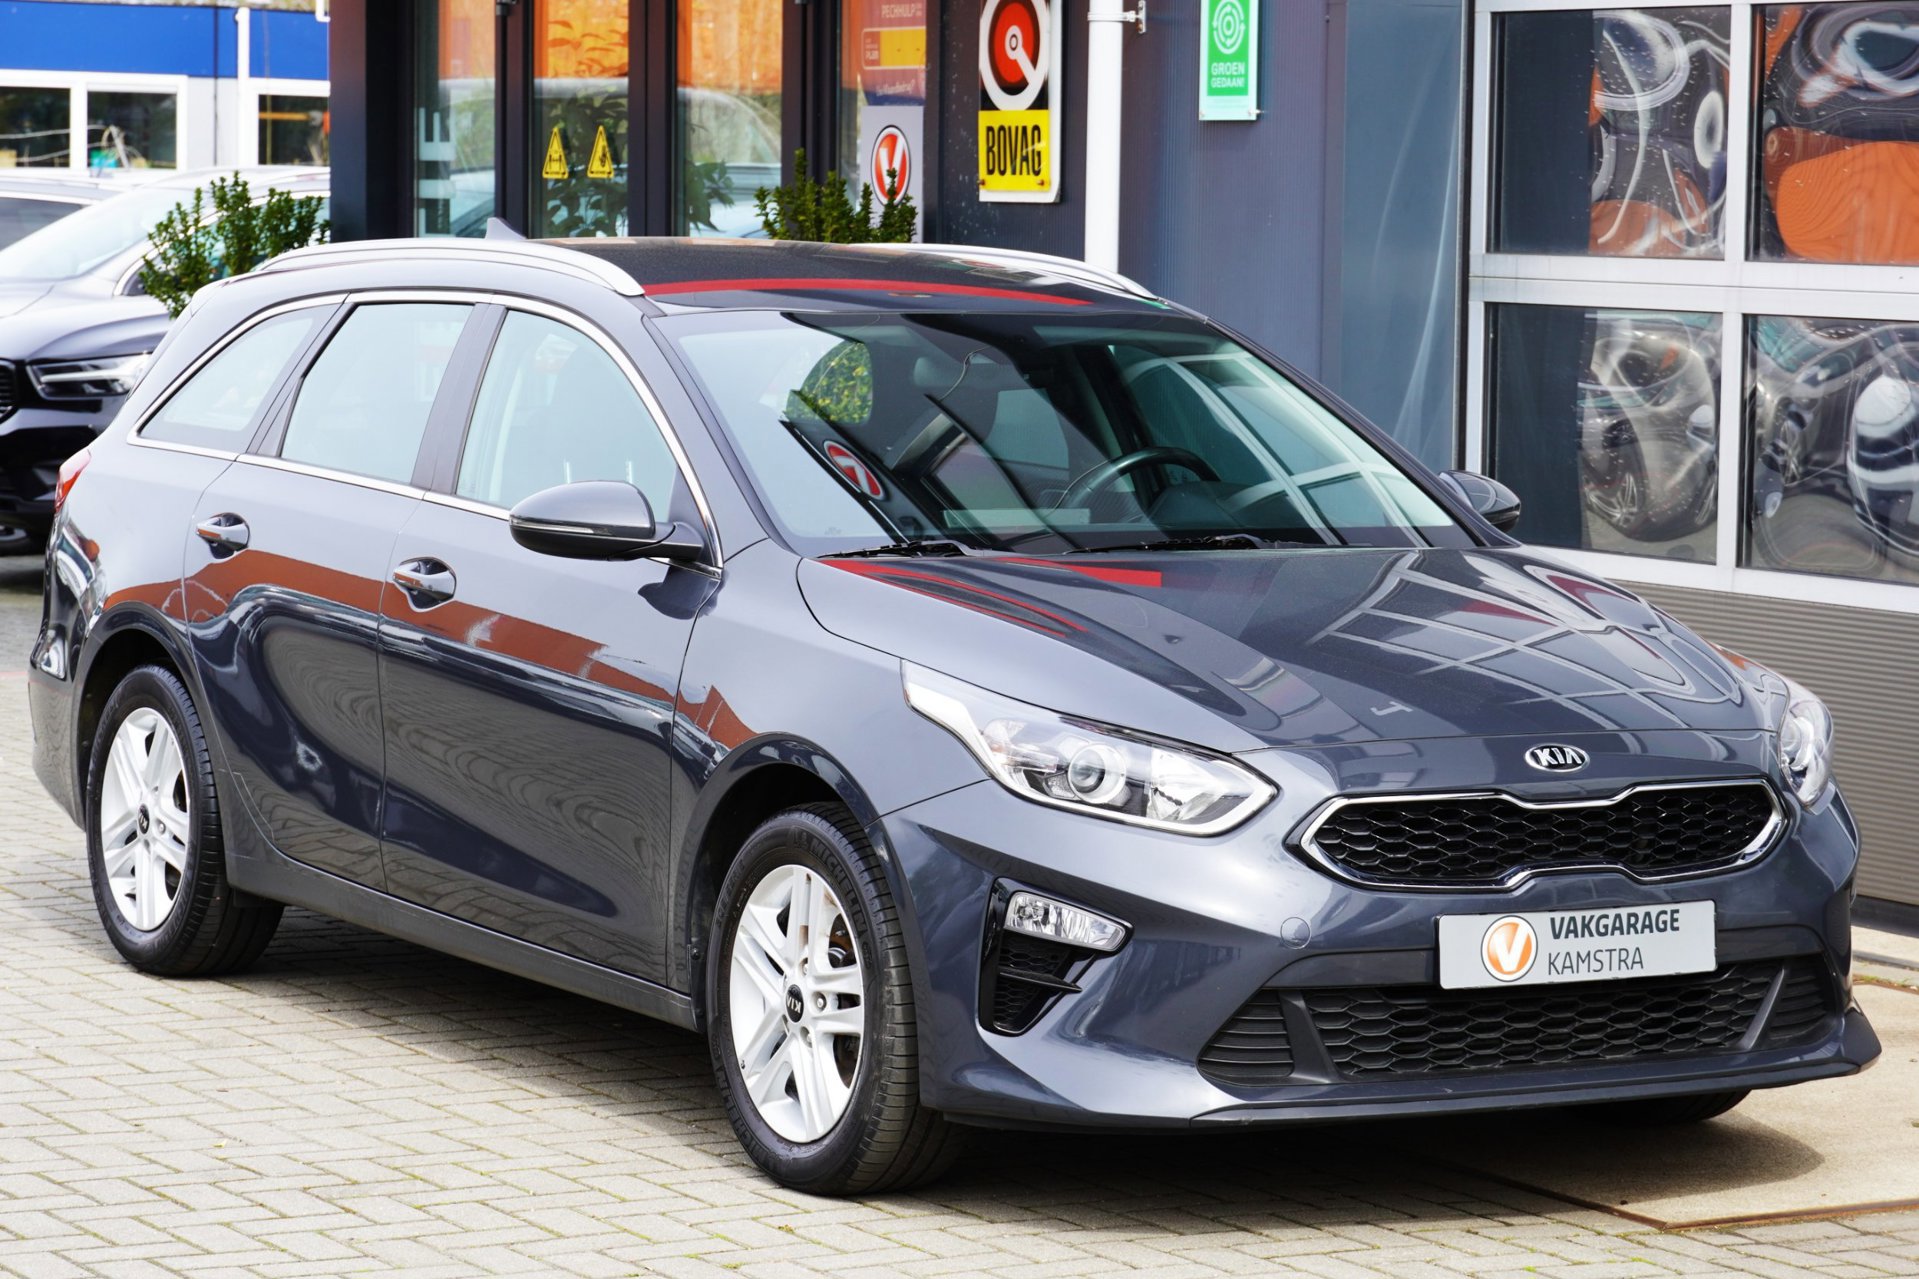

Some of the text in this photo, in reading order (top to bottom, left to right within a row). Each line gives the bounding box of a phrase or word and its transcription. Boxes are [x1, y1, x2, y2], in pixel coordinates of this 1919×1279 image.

[1210, 77, 1245, 88] GEDAAN!
[1211, 62, 1245, 75] GROEN
[986, 125, 1041, 176] BOVAG
[1535, 747, 1584, 766] KIA
[810, 841, 868, 938] MICHELIN
[1550, 909, 1680, 940] VAKGARAGE
[1548, 946, 1644, 976] KAMSTRA
